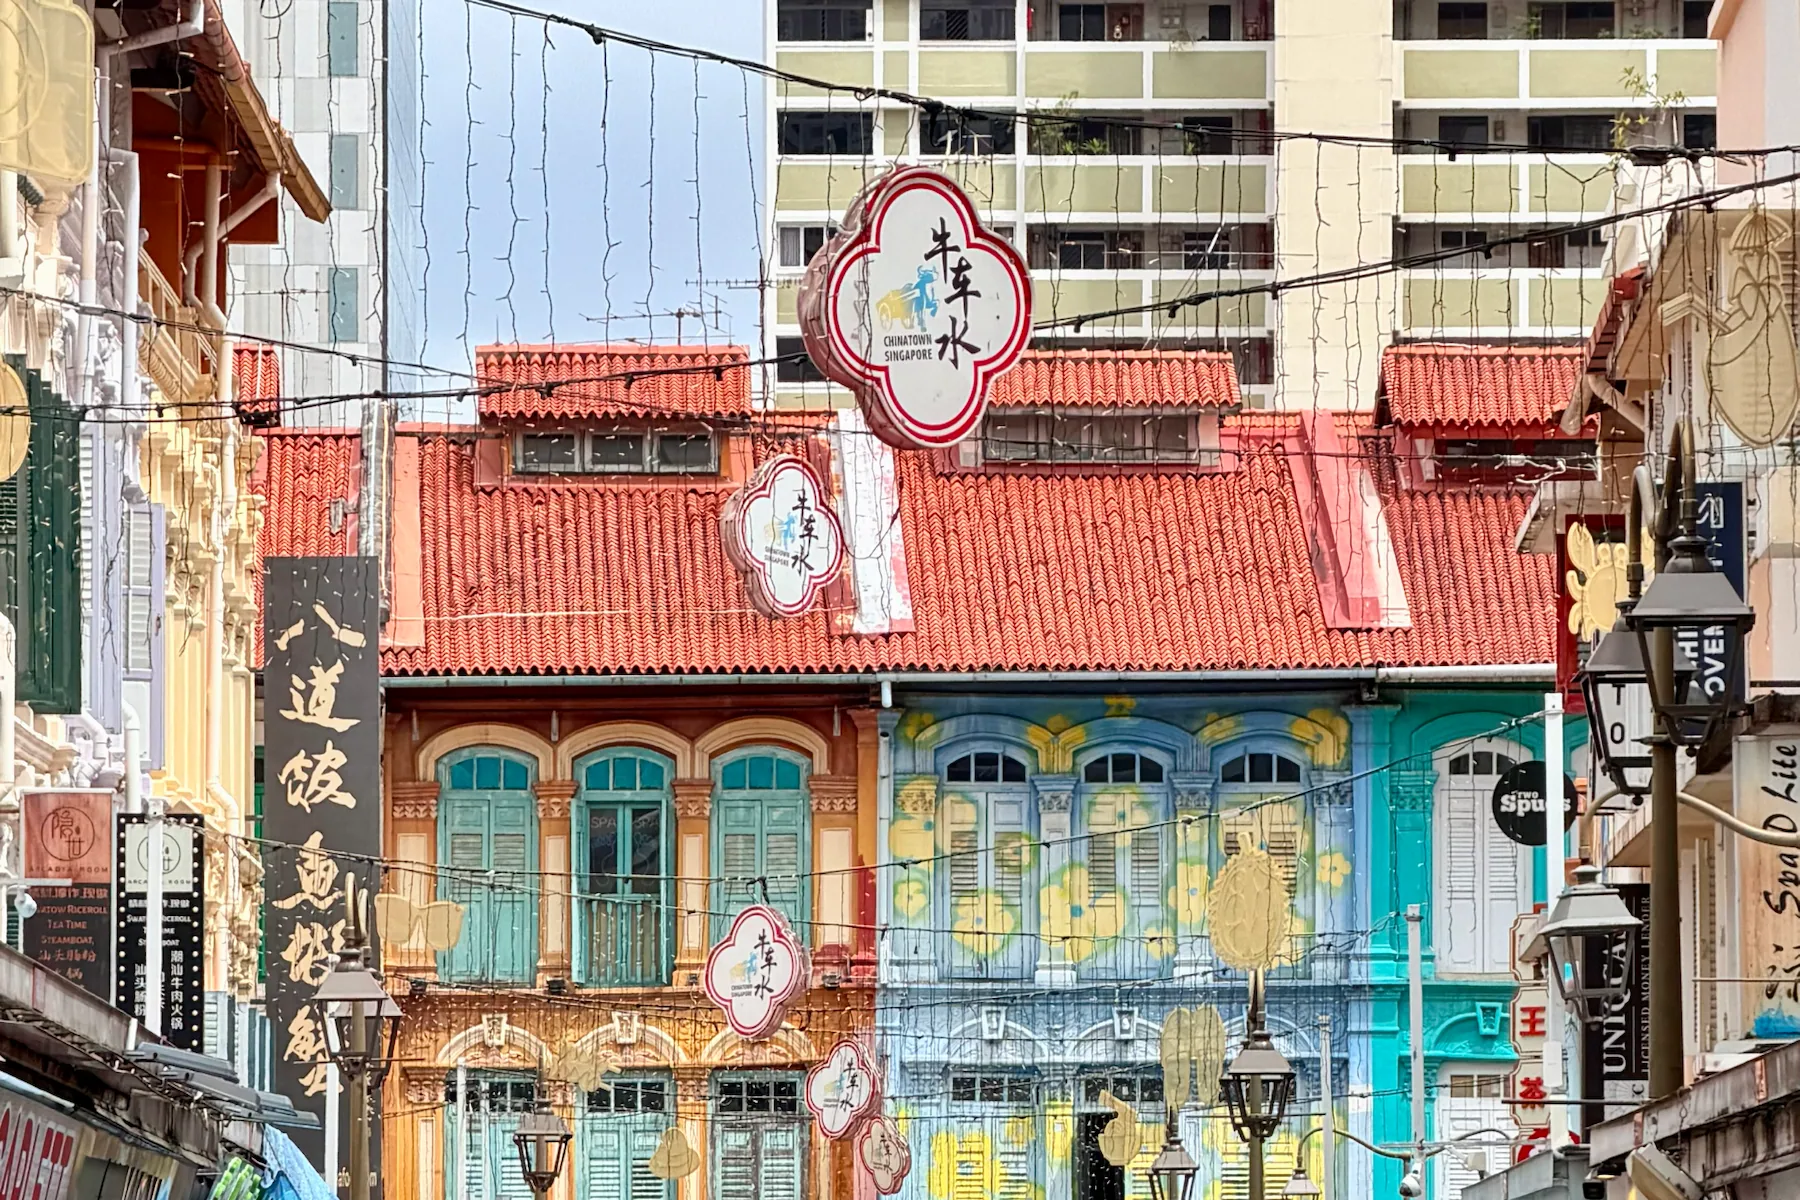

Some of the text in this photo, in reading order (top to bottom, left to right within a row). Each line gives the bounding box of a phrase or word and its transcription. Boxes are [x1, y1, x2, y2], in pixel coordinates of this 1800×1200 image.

[924, 217, 981, 370] 牛车水
[884, 333, 932, 347] CHINATOWN
[884, 349, 933, 362] SINGAPORE
[792, 493, 818, 576] 牛车水
[1761, 745, 1797, 803] Lite
[1500, 794, 1571, 817] Spus
[48, 920, 87, 929] TEA TIME
[67, 905, 108, 914] RICEROLL
[754, 929, 777, 1000] 牛车水
[1640, 954, 1650, 1001] MONEY
[1640, 1006, 1650, 1074] LICENSED
